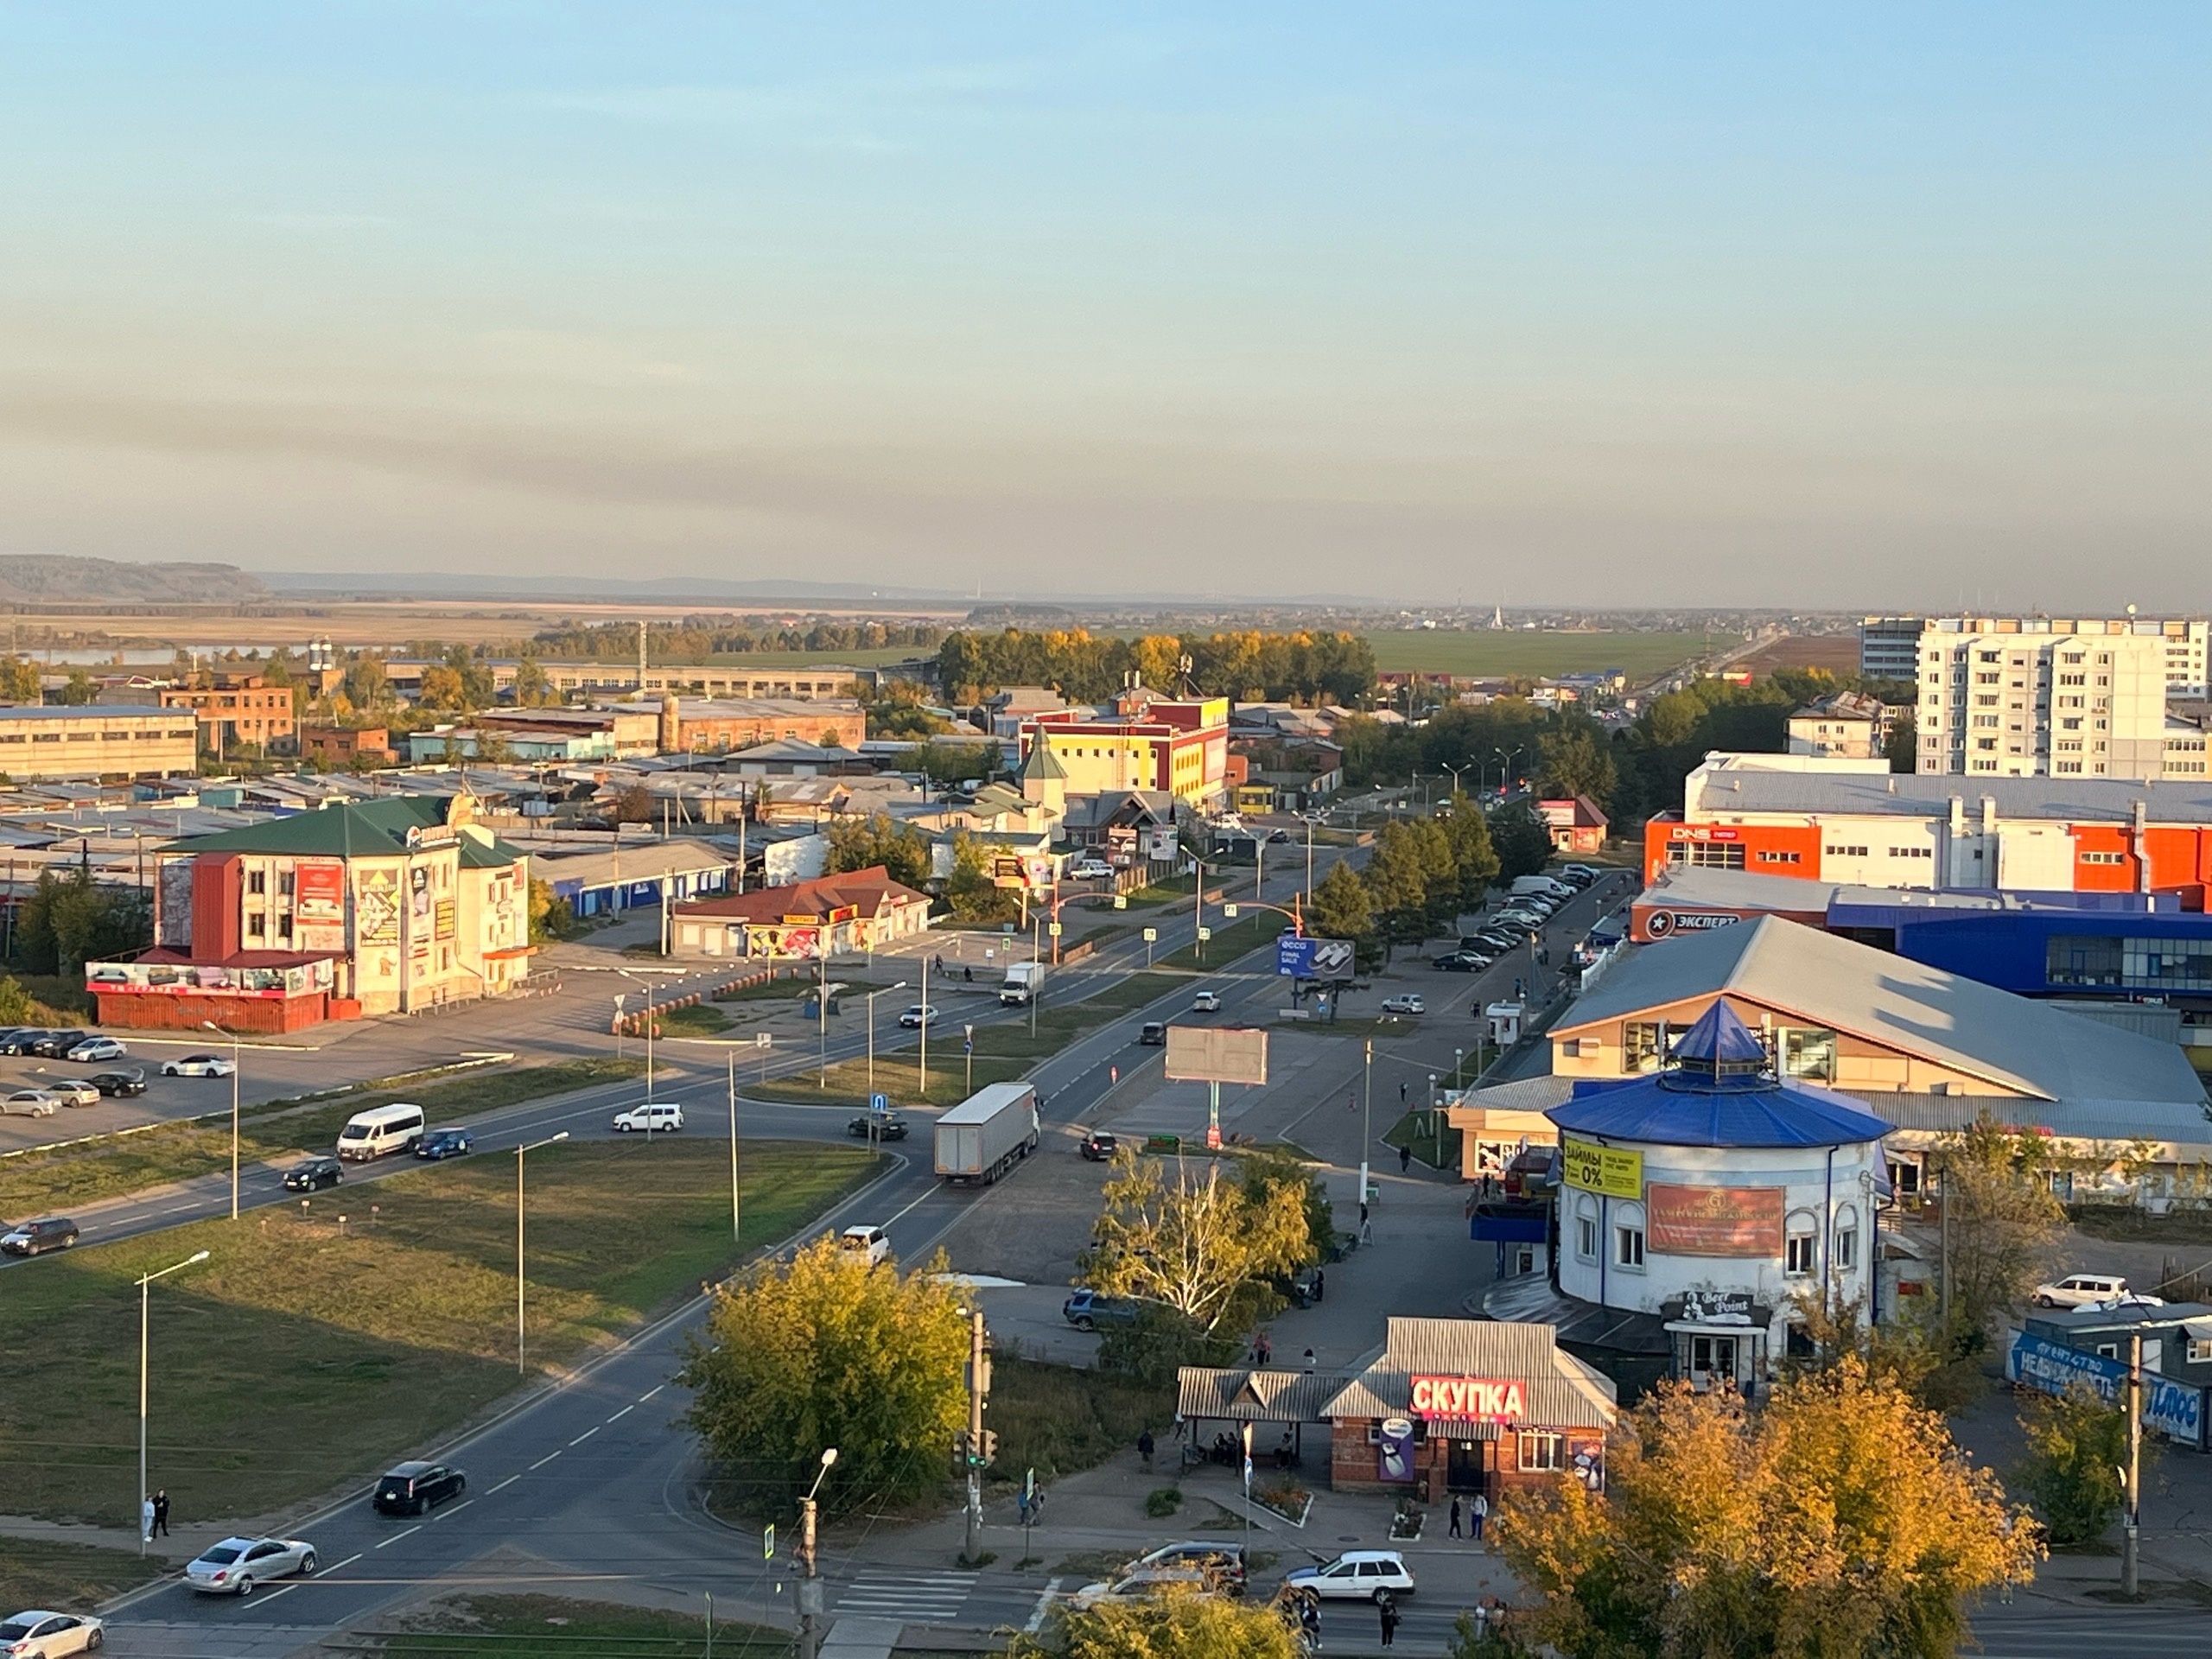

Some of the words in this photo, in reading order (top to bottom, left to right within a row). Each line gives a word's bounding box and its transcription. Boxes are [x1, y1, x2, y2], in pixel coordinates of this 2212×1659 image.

[1672, 828, 1711, 840] DNS
[1677, 916, 1737, 928] ЭКСПЕРТ
[1566, 1145, 1602, 1166] ЗАЙМЫ
[1582, 1166, 1603, 1186] 0%
[1701, 1292, 1728, 1304] Beer
[1714, 1300, 1748, 1313] Point
[1412, 1379, 1524, 1417] СКУПКА
